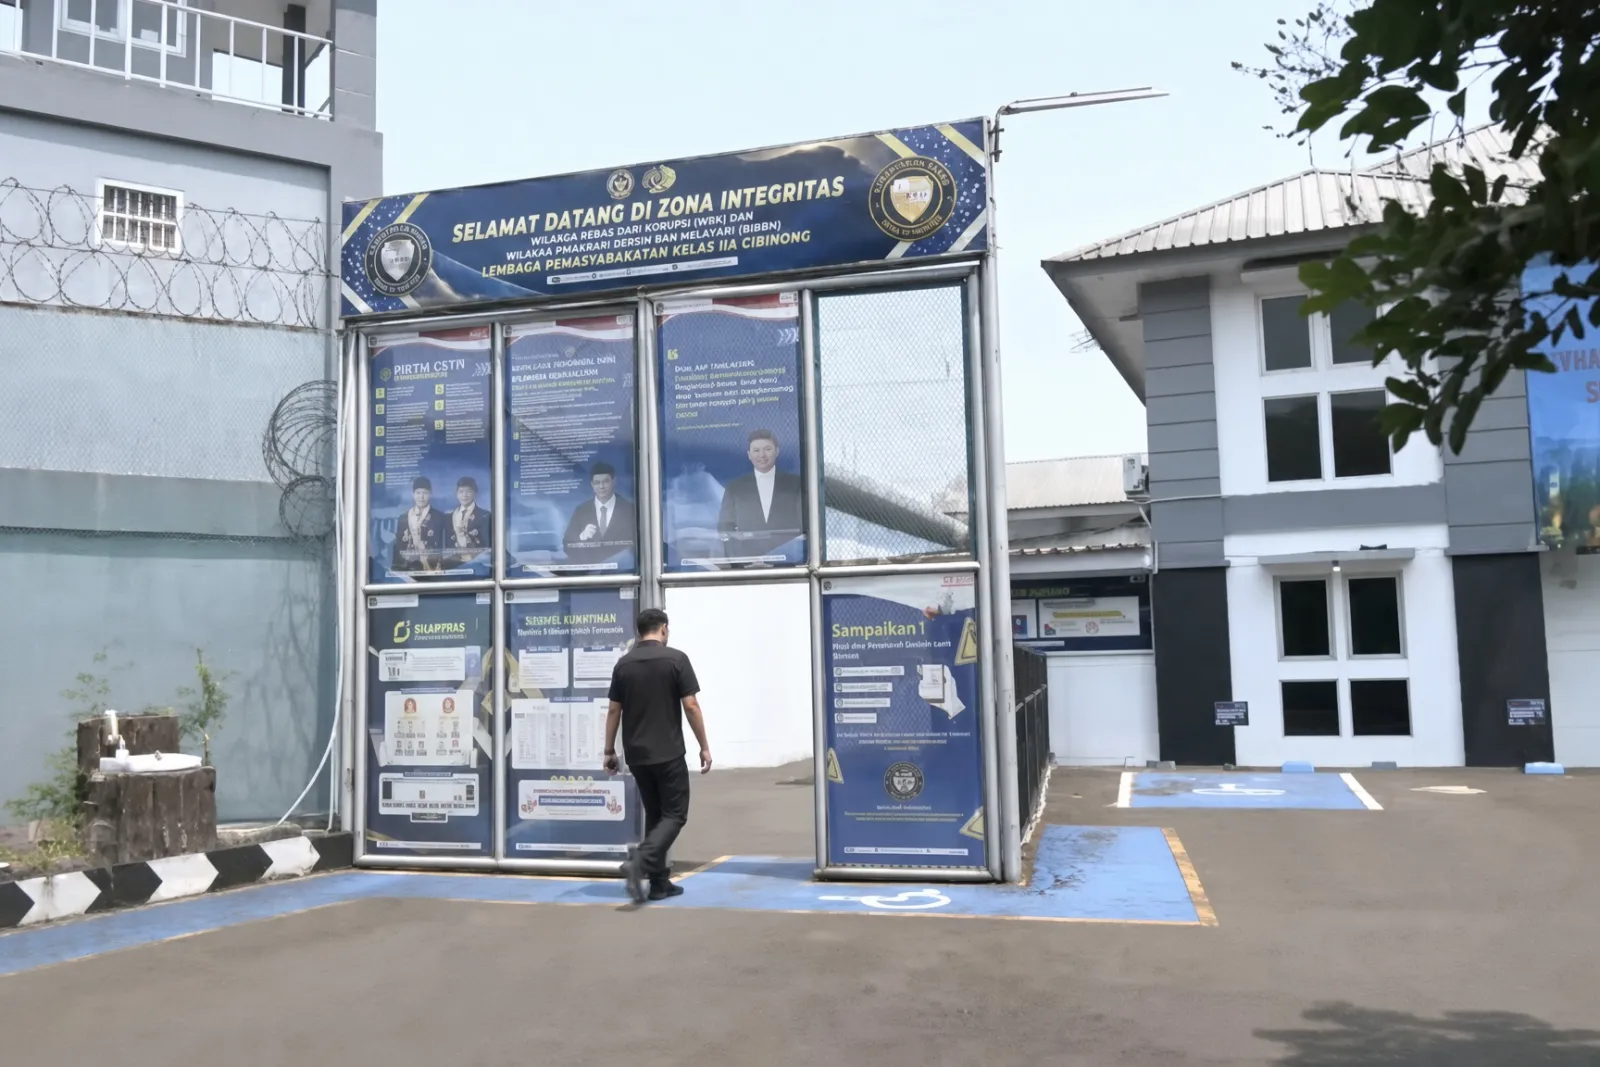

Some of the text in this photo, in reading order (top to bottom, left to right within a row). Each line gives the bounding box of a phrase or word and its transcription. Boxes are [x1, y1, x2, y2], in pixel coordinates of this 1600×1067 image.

[452, 214, 540, 243] SELAMAT
[544, 204, 625, 232] DATANG
[631, 200, 652, 222] DI
[657, 193, 713, 219] ZONA
[720, 176, 845, 210] INTEGRITAS
[617, 224, 642, 236] DARI
[645, 218, 691, 232] KORUPSI
[730, 211, 753, 223] DAN
[655, 232, 677, 244] BAN
[482, 260, 541, 278] LEMBAGA
[672, 240, 714, 256] KELAS
[719, 238, 737, 251] IIA
[742, 230, 811, 249] CIBINONG
[832, 621, 917, 640] Sampaikan
